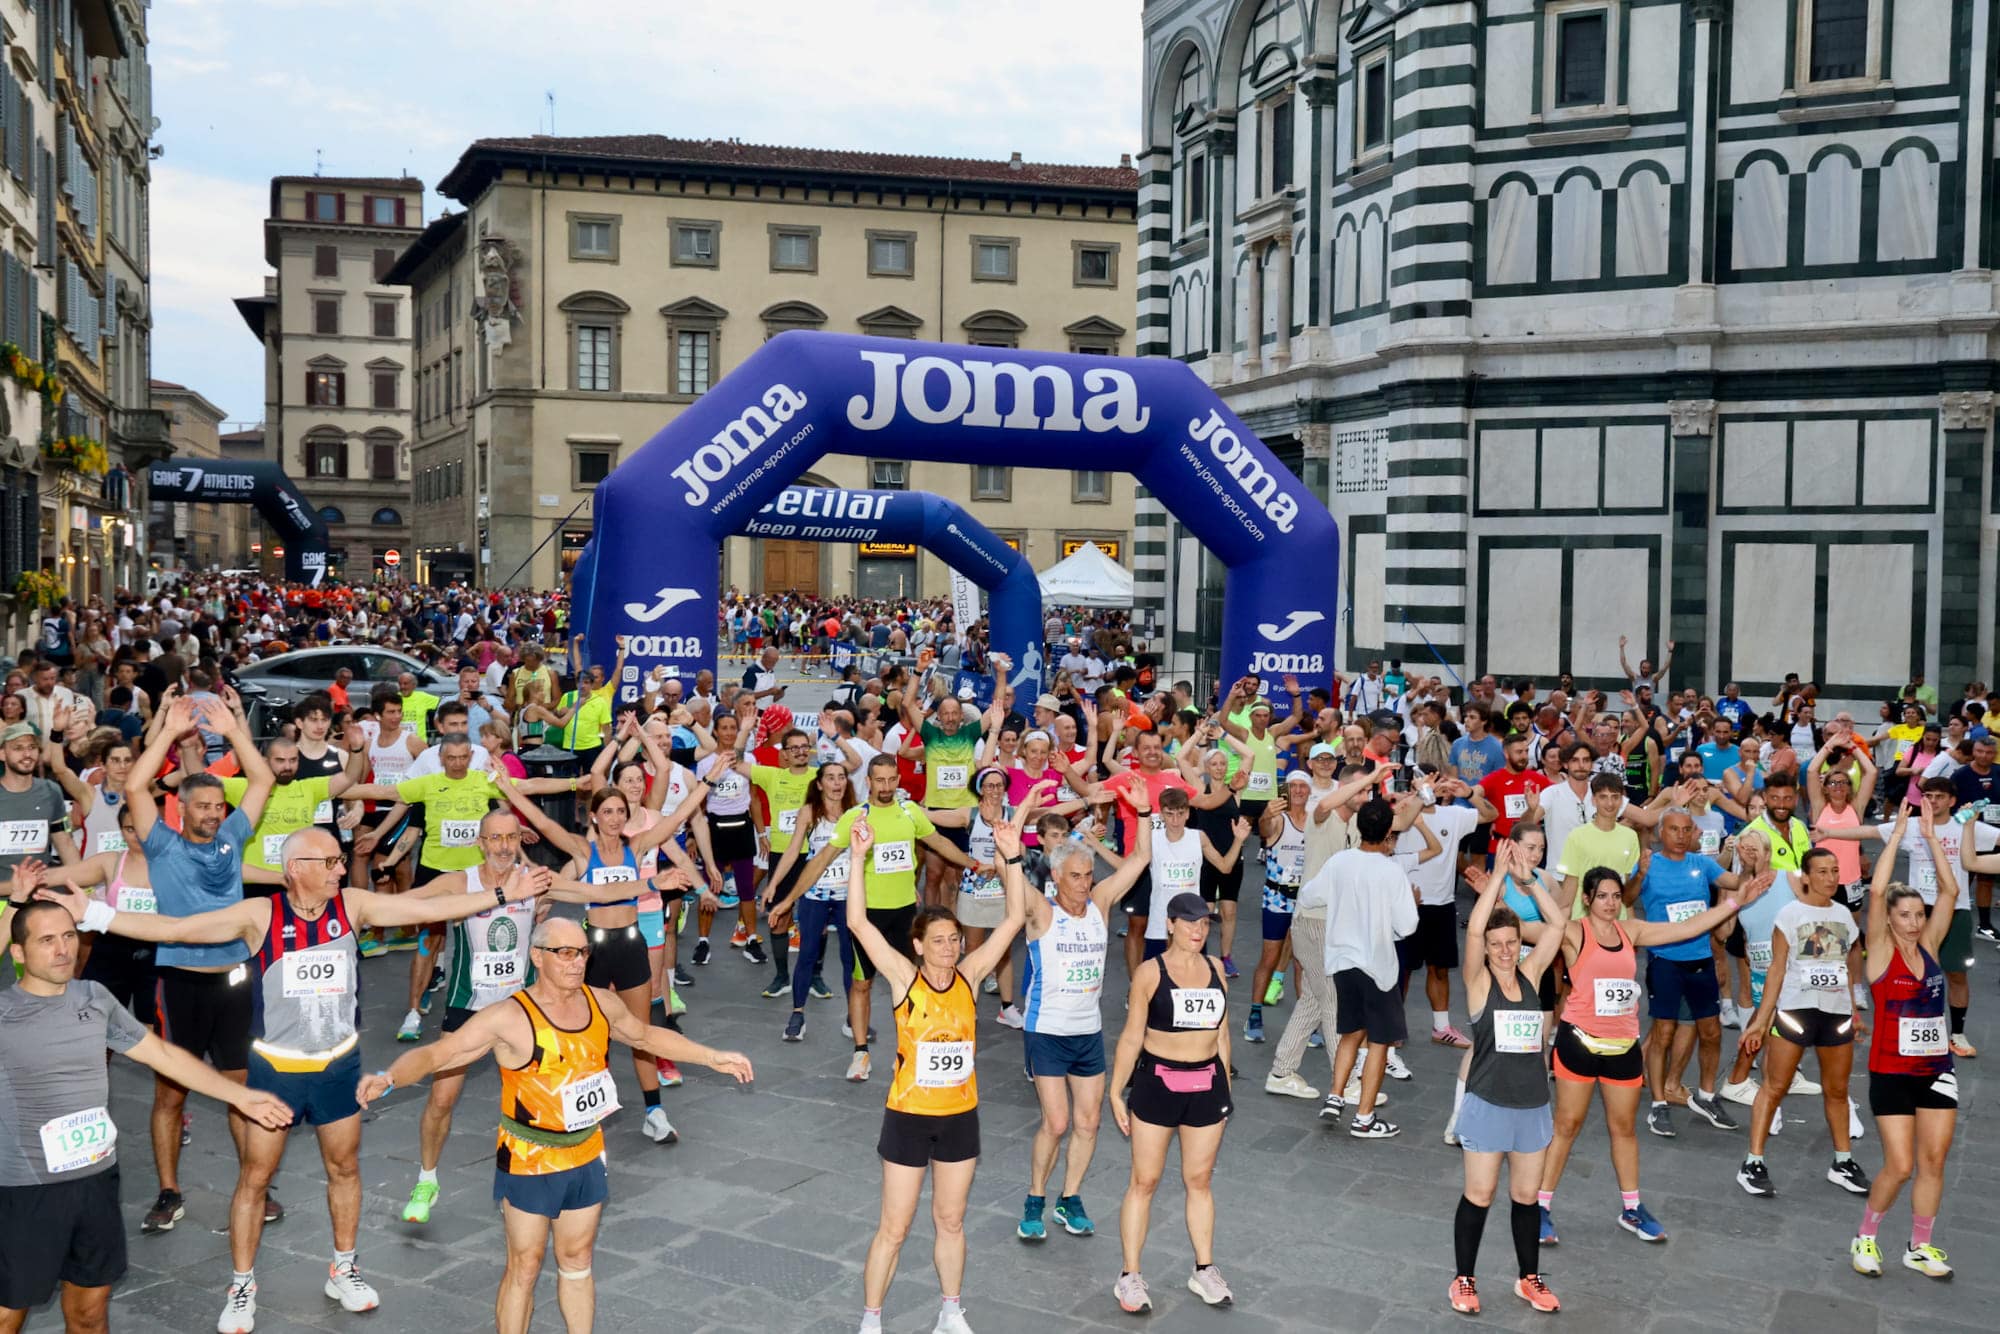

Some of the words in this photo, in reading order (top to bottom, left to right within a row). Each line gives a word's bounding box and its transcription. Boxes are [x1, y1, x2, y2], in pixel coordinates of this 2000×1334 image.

[847, 350, 1150, 433] Joma
[670, 383, 807, 506] Joma
[711, 423, 814, 514] www.joma-sport.com
[1188, 408, 1298, 533] Joma
[153, 470, 182, 487] GAME
[180, 467, 204, 492] 7
[203, 473, 254, 490] ATHLETICS
[1180, 443, 1264, 541] www.joma-sport.com
[745, 518, 796, 536] keep
[801, 526, 878, 541] moving
[302, 552, 326, 565] GAME
[954, 530, 1009, 575] PHARMANUTRA
[616, 635, 703, 659] Joma
[1248, 651, 1324, 674] Joma
[943, 772, 961, 781] 263
[1252, 777, 1269, 785] 899
[718, 782, 738, 791] 954
[1513, 801, 1525, 809] 91
[10, 830, 39, 842] 777
[446, 828, 475, 838] 1061
[882, 849, 906, 862] 952
[1167, 867, 1193, 879] 1916
[1056, 943, 1088, 953] ATLETICA
[296, 963, 334, 980] 609
[484, 961, 515, 976] 188
[1066, 967, 1099, 981] 2334
[1810, 974, 1839, 986] 893
[1605, 989, 1632, 1002] 932
[1185, 999, 1216, 1013] 874
[1504, 1023, 1540, 1037] 1827
[1911, 1028, 1939, 1042] 588
[929, 1056, 963, 1071] 599
[576, 1087, 605, 1112] 601
[56, 1122, 107, 1151] 1927
